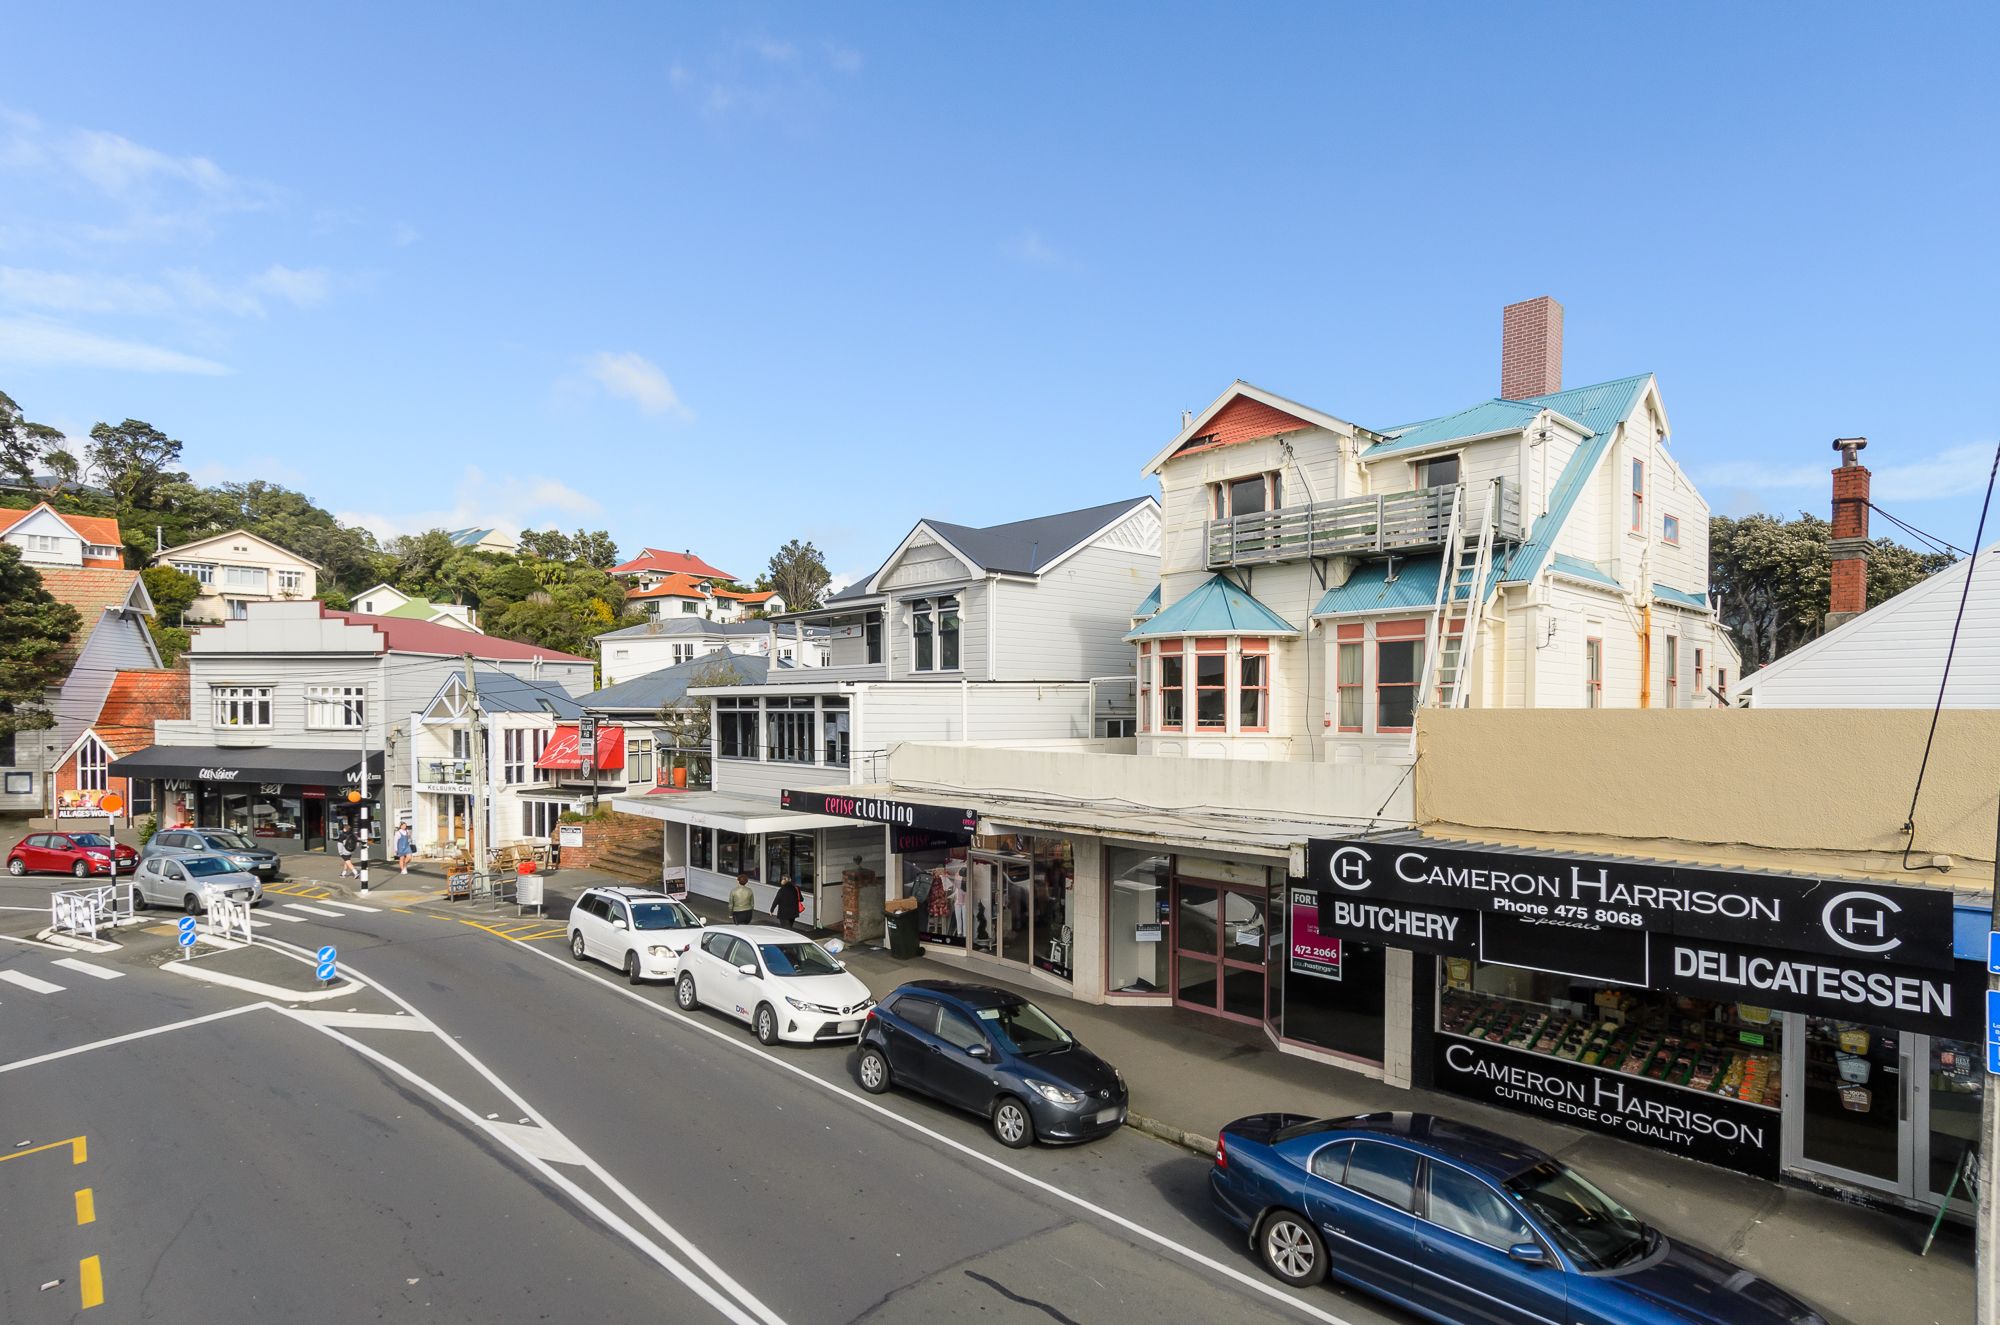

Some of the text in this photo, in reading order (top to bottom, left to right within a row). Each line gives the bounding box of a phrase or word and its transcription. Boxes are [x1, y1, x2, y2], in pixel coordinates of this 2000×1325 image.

[825, 796, 913, 826] cerise clothing
[1294, 893, 1311, 904] FOR
[1395, 853, 1781, 922] CAMERON HARRISON
[1335, 901, 1459, 941] BUTCHERY
[1494, 898, 1643, 926] Phone 475 8068
[1294, 944, 1311, 955] 472
[1313, 948, 1337, 959] 2066
[1674, 946, 1952, 1016] DELICATESSEN
[1446, 1045, 1764, 1149] CAMERON HARRISON
[1495, 1085, 1695, 1146] CUTTING EDGE OF QUALITY
